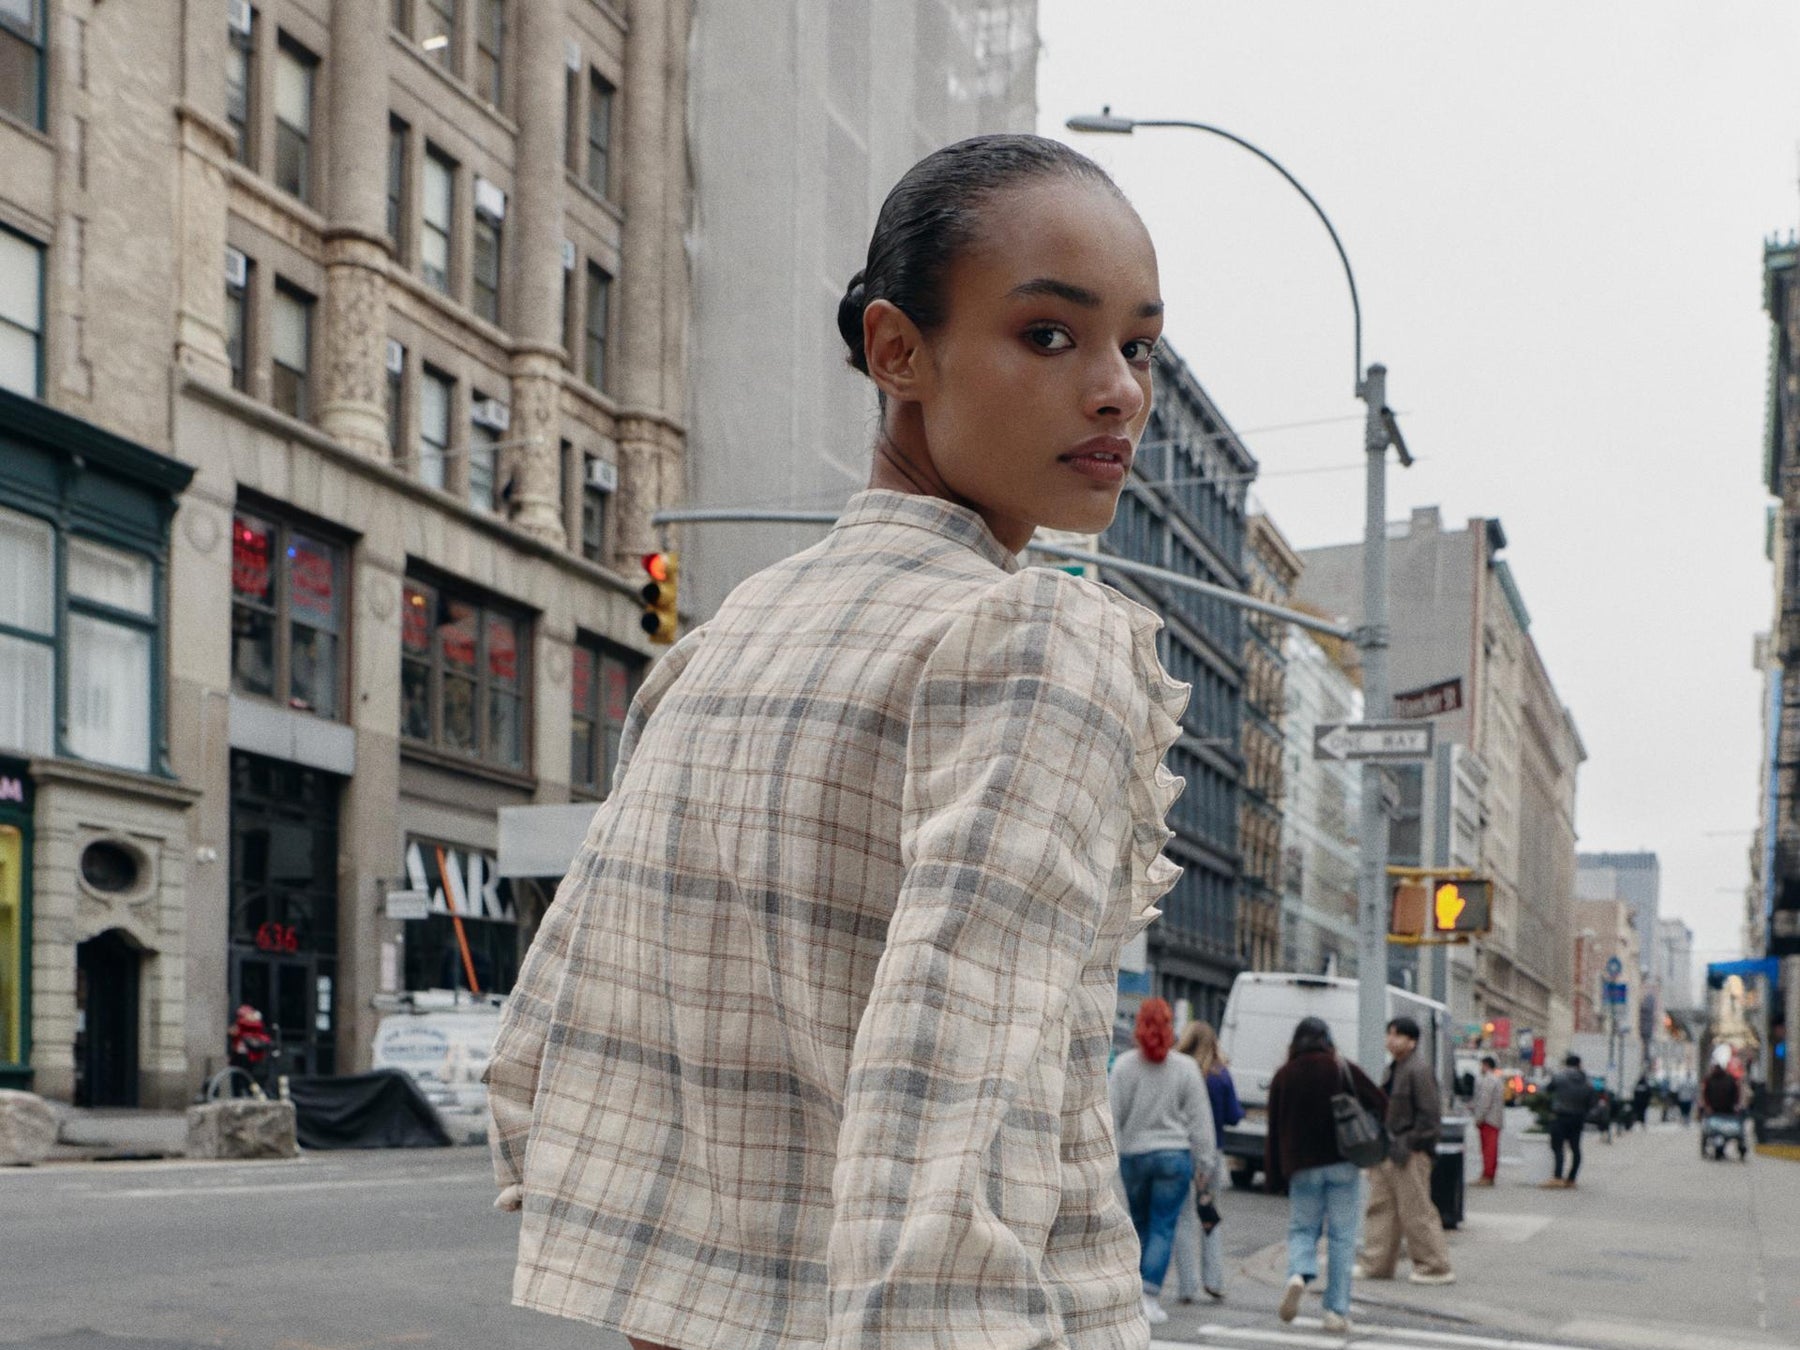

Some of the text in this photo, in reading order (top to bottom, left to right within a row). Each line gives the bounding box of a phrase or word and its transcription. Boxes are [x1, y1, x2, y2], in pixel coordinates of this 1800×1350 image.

[1330, 734, 1418, 750] ONE WAY
[256, 921, 298, 953] 636
